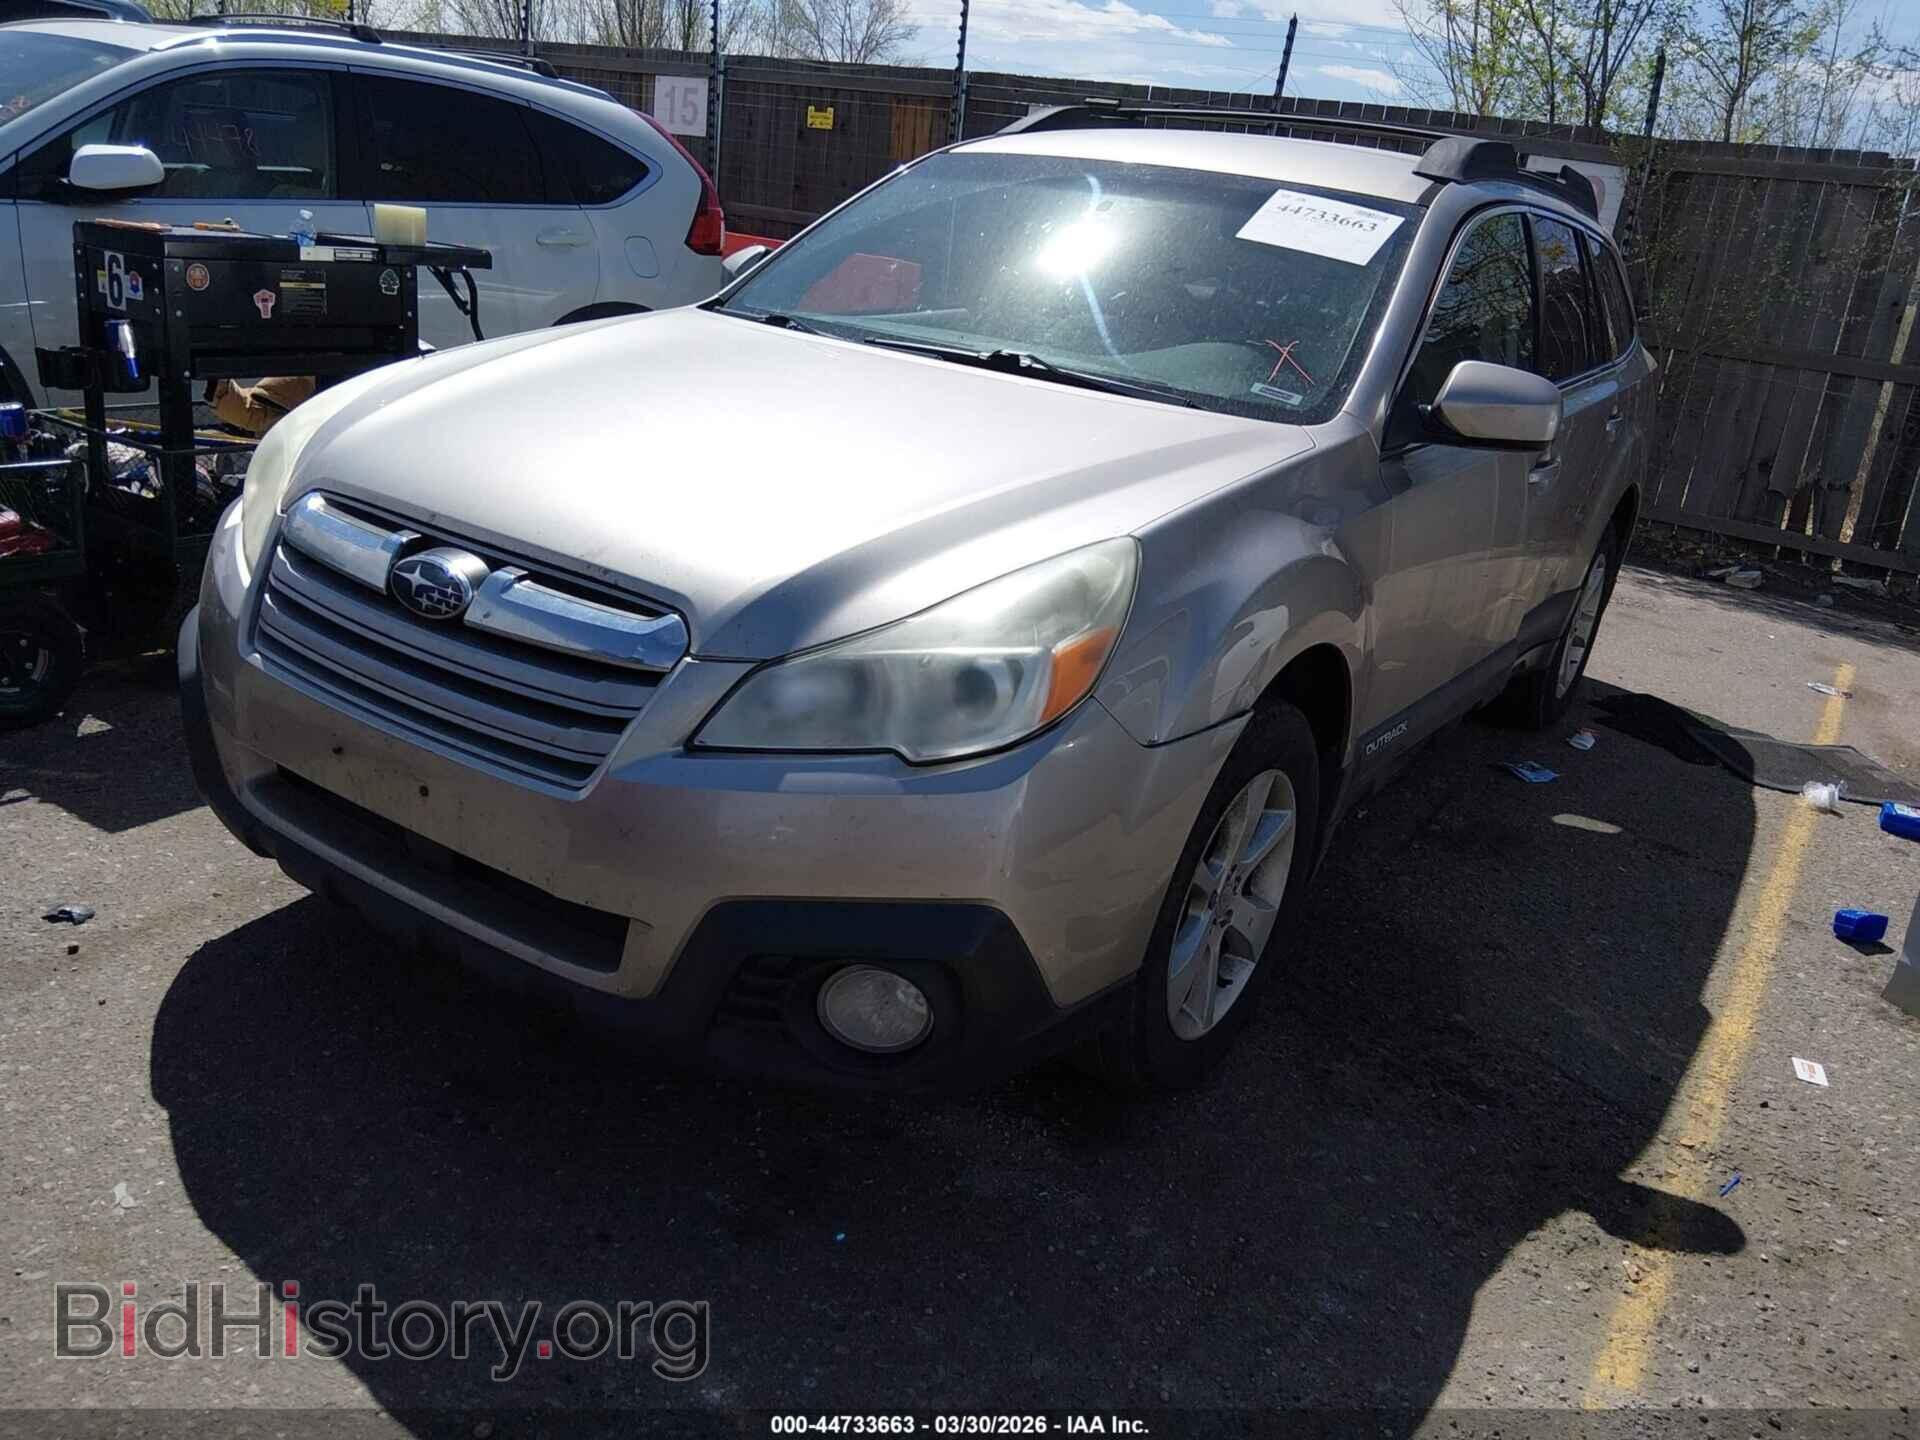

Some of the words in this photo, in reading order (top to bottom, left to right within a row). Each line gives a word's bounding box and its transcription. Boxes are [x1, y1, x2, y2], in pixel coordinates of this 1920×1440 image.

[664, 86, 699, 126] 15
[1277, 204, 1378, 232] 44733663
[107, 254, 124, 307] 6
[1365, 719, 1408, 756] OUTBACK
